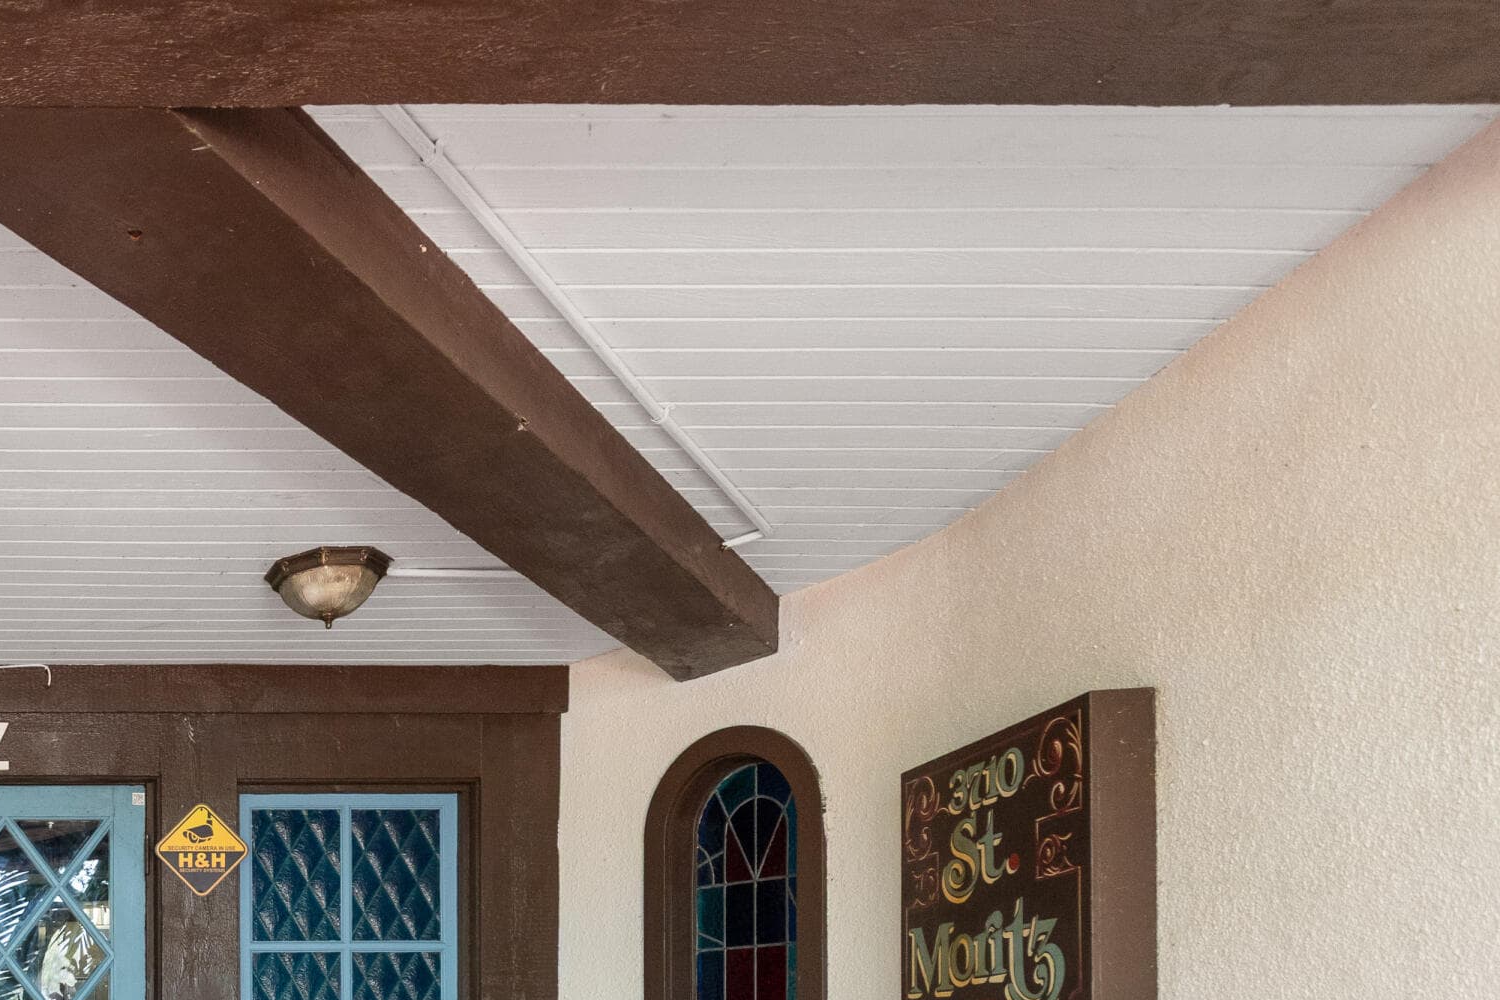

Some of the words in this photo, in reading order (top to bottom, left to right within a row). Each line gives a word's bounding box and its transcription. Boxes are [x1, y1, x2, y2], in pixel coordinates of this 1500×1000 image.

[947, 746, 1025, 815] 3710
[178, 852, 226, 868] H&H
[941, 809, 1021, 905] St.
